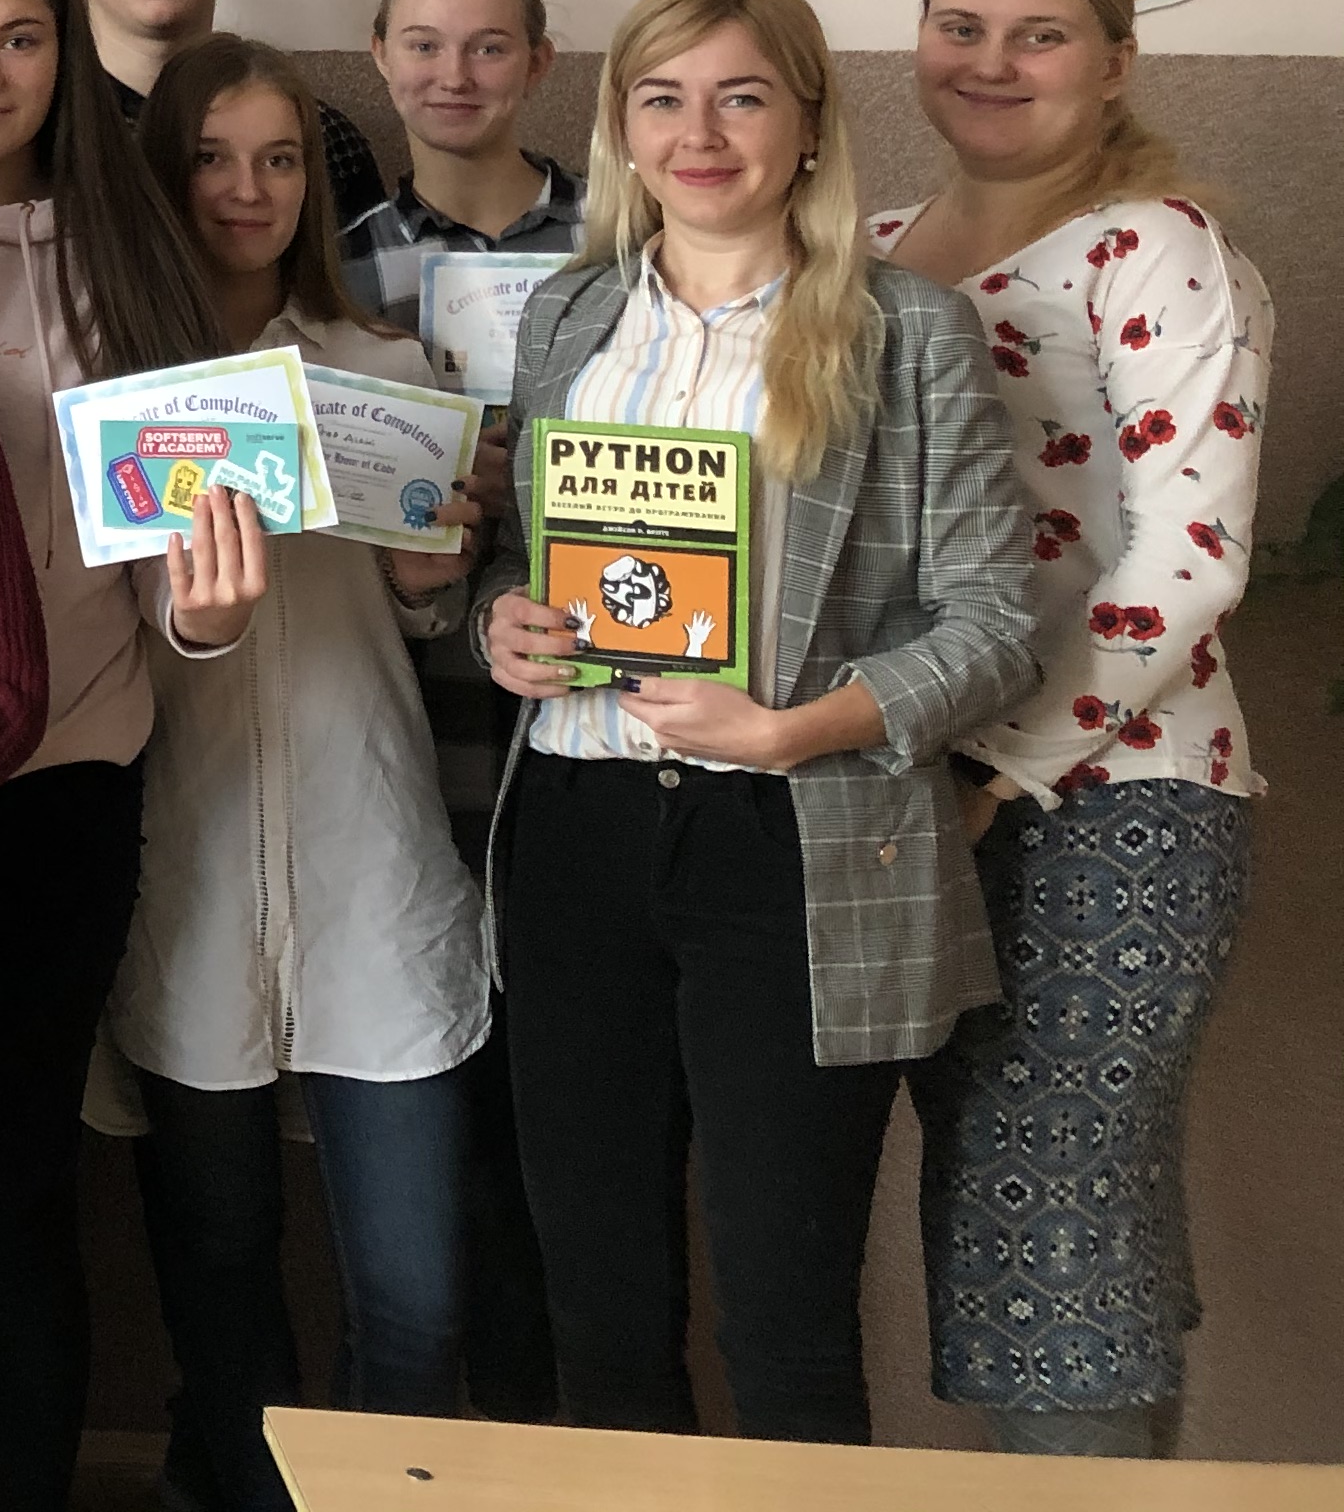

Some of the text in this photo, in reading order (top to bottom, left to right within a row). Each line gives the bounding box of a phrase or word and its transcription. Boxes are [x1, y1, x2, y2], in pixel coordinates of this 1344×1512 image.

[515, 278, 529, 293] of
[164, 396, 181, 416] of
[184, 394, 279, 422] Completion
[145, 432, 222, 444] SOFTSERVE
[351, 402, 368, 418] of
[370, 406, 445, 461] Completion
[142, 443, 225, 454] IT ACADEMY
[550, 438, 727, 479] PYTHON
[558, 475, 718, 504] ДЛЯ ДІТЕЙ
